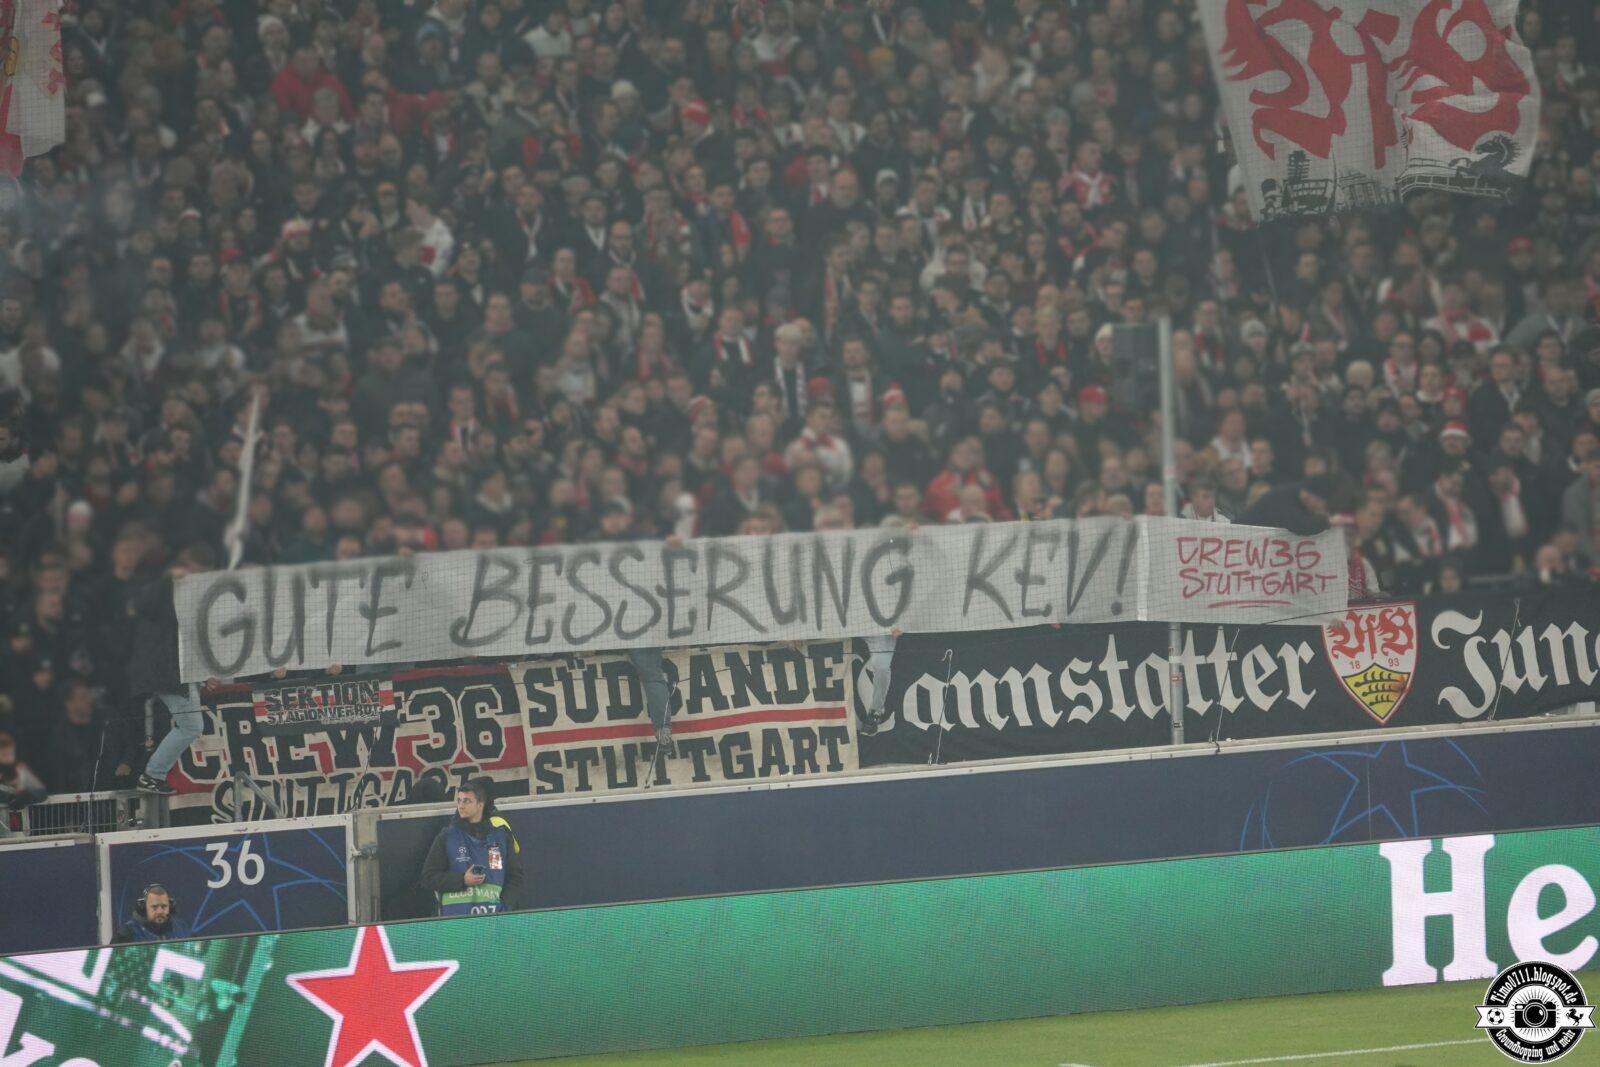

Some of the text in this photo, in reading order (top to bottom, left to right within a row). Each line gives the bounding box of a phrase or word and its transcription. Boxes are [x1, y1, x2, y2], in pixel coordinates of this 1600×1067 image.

[198, 520, 1140, 675] GUTE BESSERUNG KEV!
[1178, 566, 1339, 599] STUTTGART
[1349, 658, 1400, 670] 18 93
[1431, 609, 1600, 719] Jun
[264, 680, 380, 711] SEKTION
[534, 726, 850, 795] STUTTGART
[205, 841, 266, 890] 36
